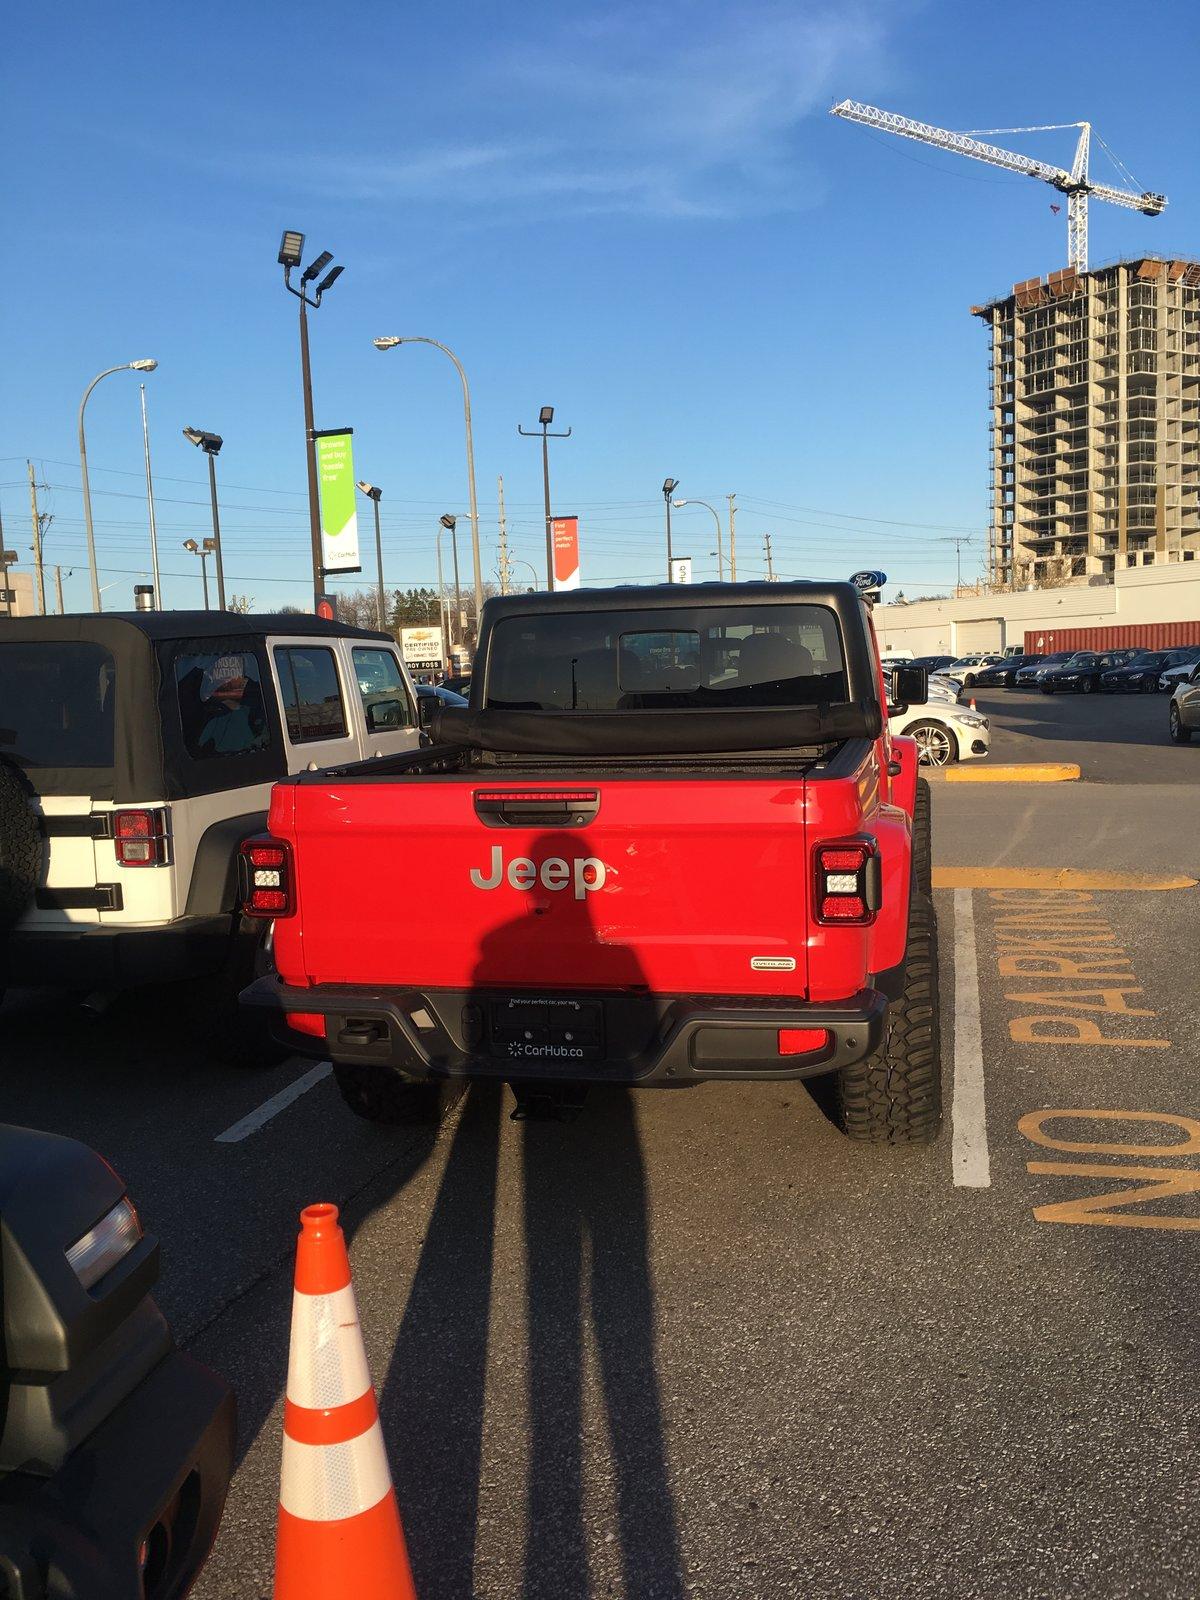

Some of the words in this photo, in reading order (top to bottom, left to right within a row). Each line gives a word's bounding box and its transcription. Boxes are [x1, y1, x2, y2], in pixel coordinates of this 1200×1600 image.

[321, 452, 333, 460] and
[334, 451, 347, 460] buy
[854, 574, 873, 587] Ford
[213, 667, 243, 680] NATION
[470, 845, 607, 900] Jeep
[988, 889, 1172, 1048] PARKING
[524, 1044, 584, 1057] CarHub.ca
[1017, 1109, 1200, 1231] NO
